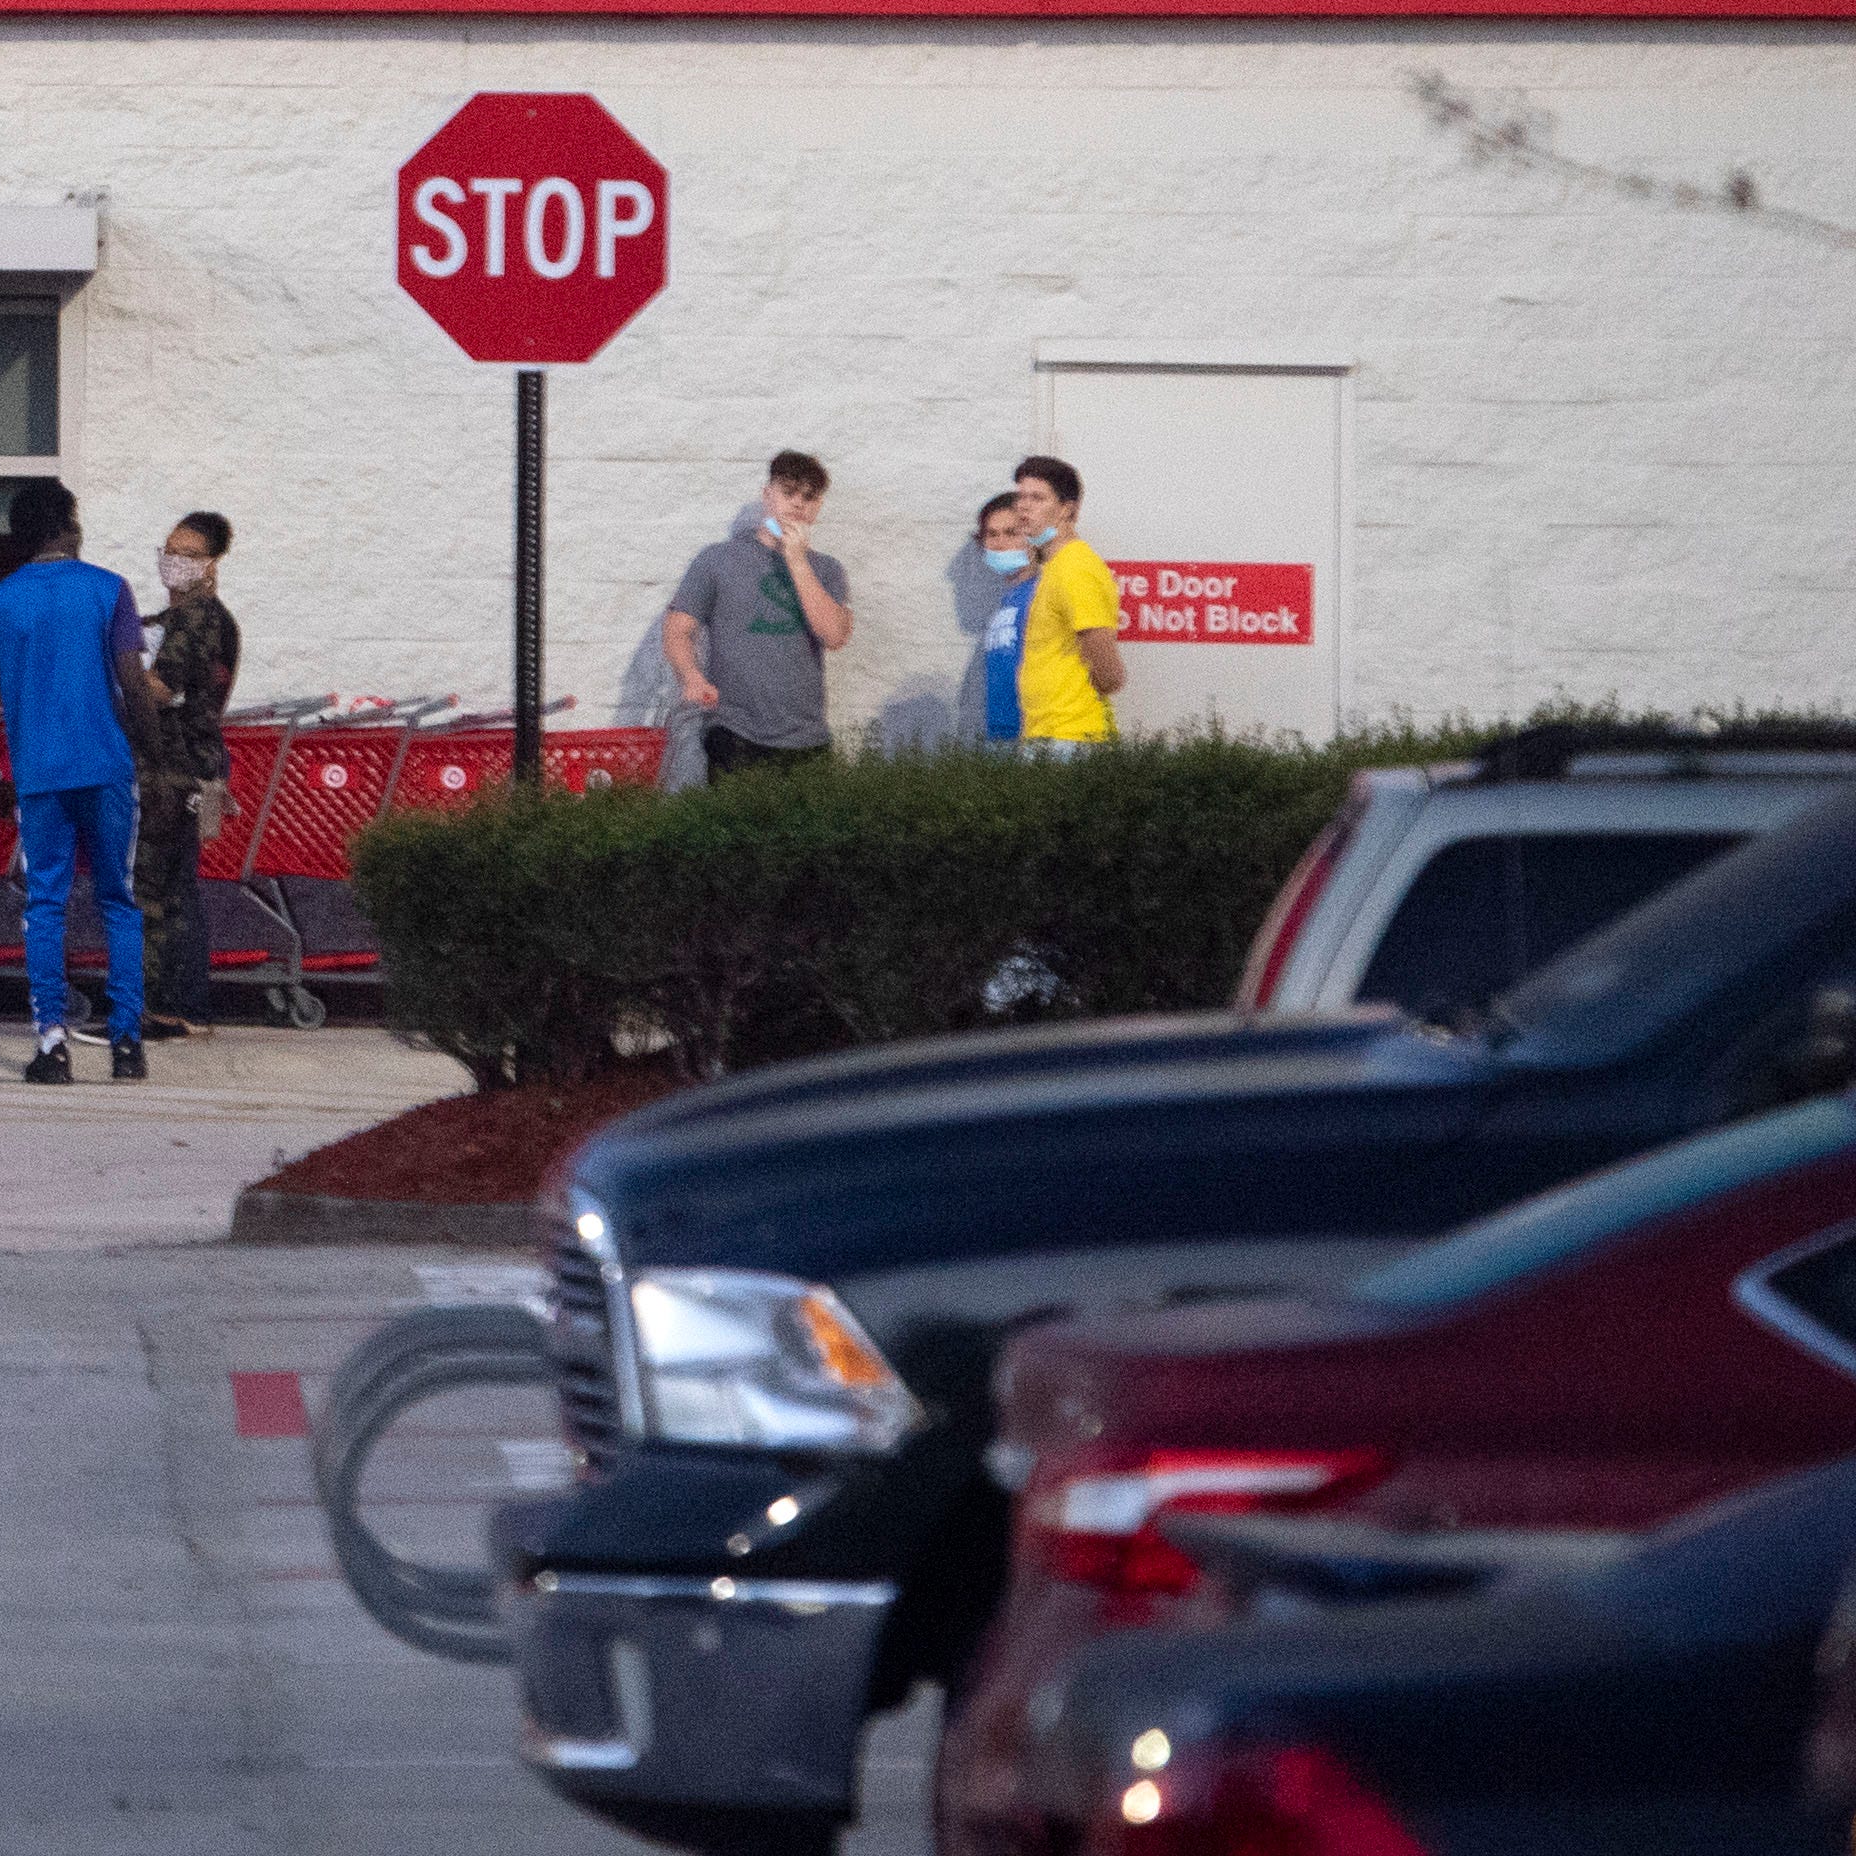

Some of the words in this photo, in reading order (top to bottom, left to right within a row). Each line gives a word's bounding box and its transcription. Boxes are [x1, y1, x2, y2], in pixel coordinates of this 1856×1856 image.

[410, 176, 655, 278] STOP
[1115, 574, 1149, 597] re
[1159, 570, 1237, 598] Door
[1140, 604, 1197, 632] Not
[1206, 604, 1300, 633] Block
